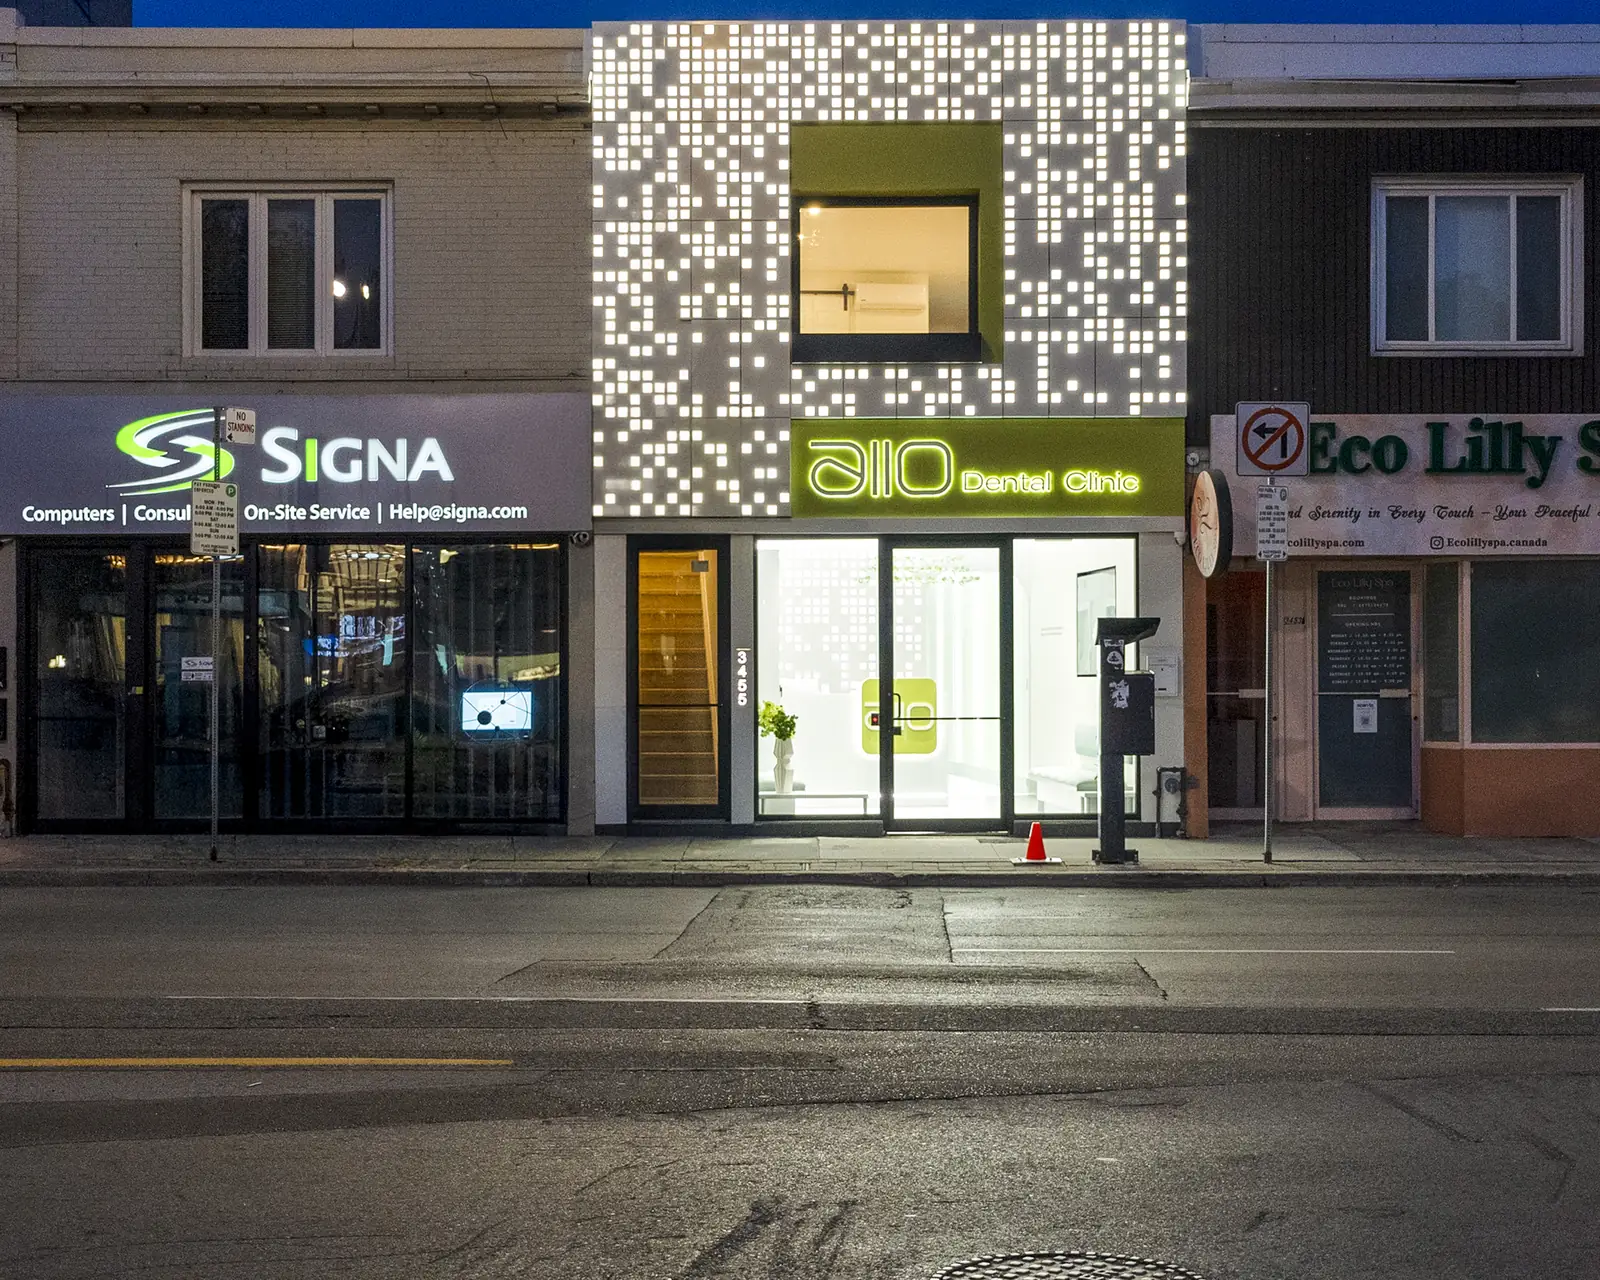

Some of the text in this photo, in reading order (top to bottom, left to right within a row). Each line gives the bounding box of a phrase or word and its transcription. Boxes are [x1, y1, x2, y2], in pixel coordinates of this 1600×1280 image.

[228, 422, 255, 433] STANDING
[236, 412, 246, 421] NO
[261, 426, 455, 483] SIGNA
[1309, 417, 1600, 488] Eco Lilly S
[809, 440, 952, 497] allo
[962, 470, 1139, 493] Dental Clinic
[22, 505, 115, 525] Computers
[134, 504, 191, 521] Consul
[244, 503, 307, 521] On-Site
[309, 503, 371, 521] Service
[390, 503, 528, 523] Help@signa.com
[1287, 505, 1303, 518] nd
[1308, 506, 1361, 523] Serenity
[1368, 507, 1381, 518] in
[1387, 505, 1427, 523] Every
[1432, 504, 1474, 519] Touch
[1493, 504, 1527, 521] Your
[1534, 504, 1592, 522] Peaceful
[1287, 538, 1548, 549] colillyspa.com Ecolillyspa.canada
[737, 651, 748, 706] 3455
